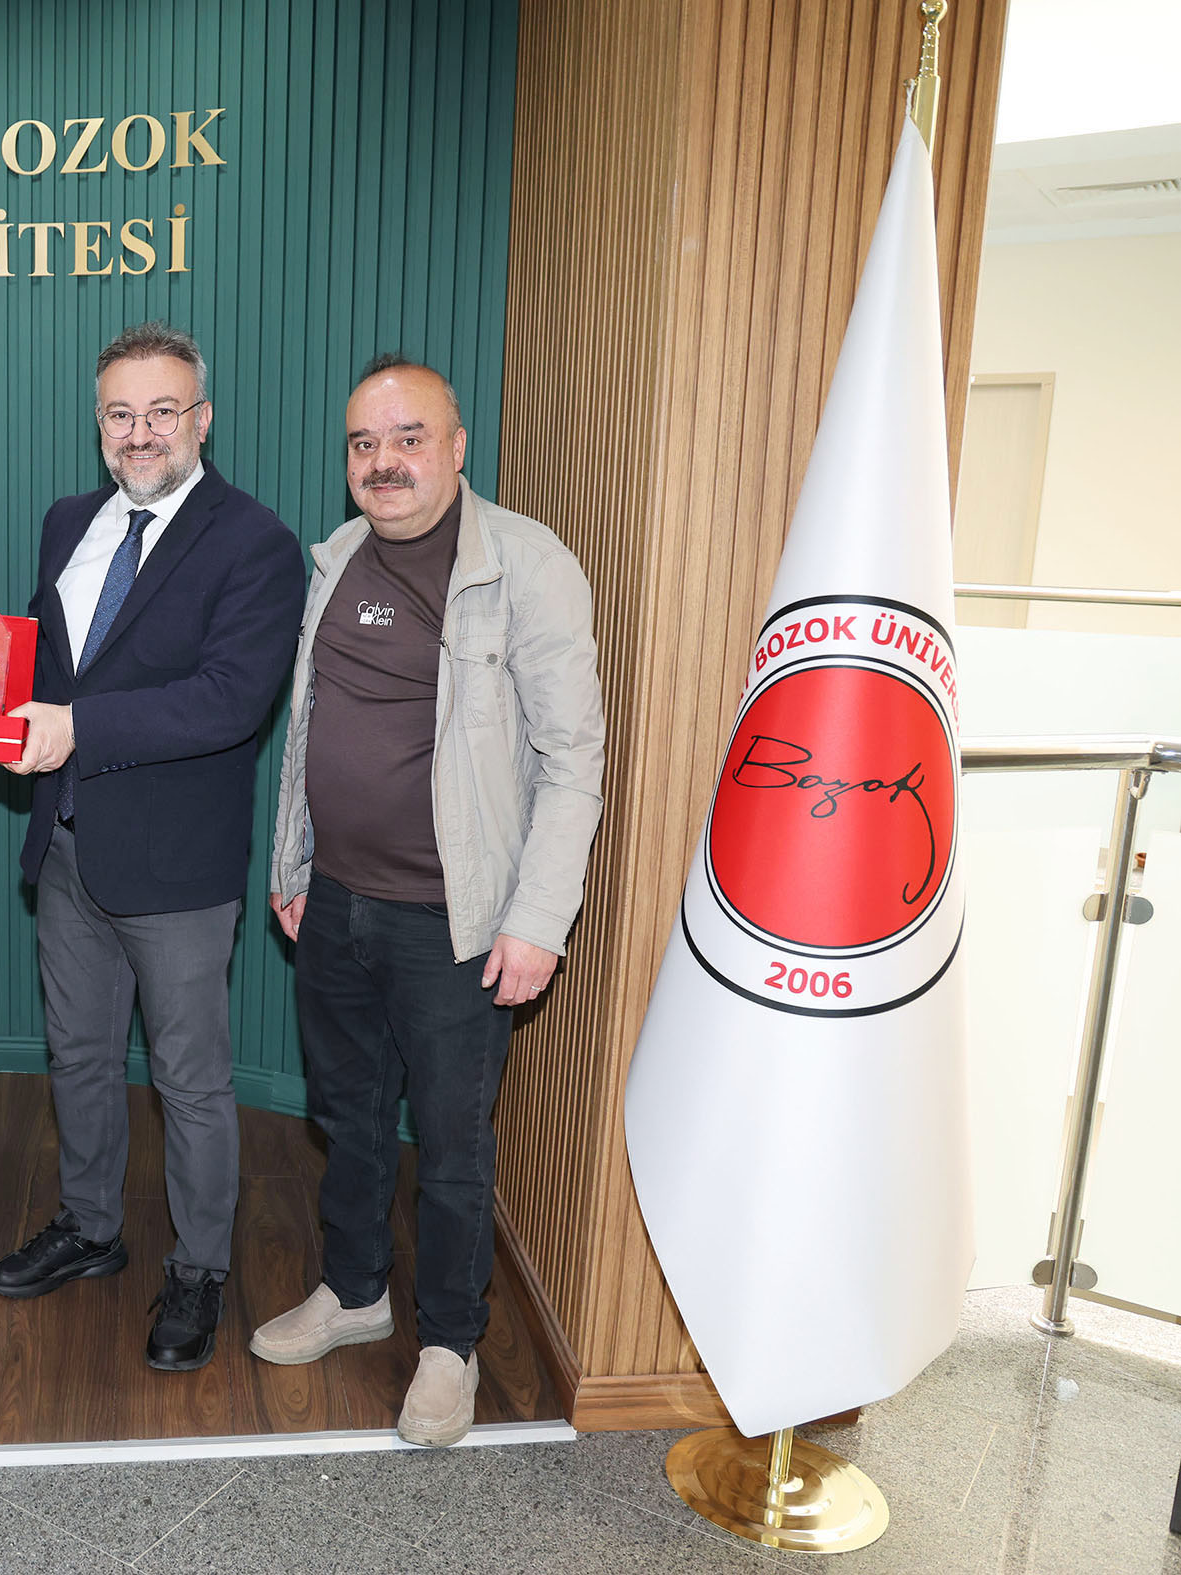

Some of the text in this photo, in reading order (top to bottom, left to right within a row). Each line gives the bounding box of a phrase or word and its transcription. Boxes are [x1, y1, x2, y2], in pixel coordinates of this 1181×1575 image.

[357, 600, 395, 617] Calvin
[372, 613, 393, 626] Klein
[755, 615, 858, 673] BOZOK
[732, 734, 936, 905] Bozok
[764, 961, 853, 999] 2006
